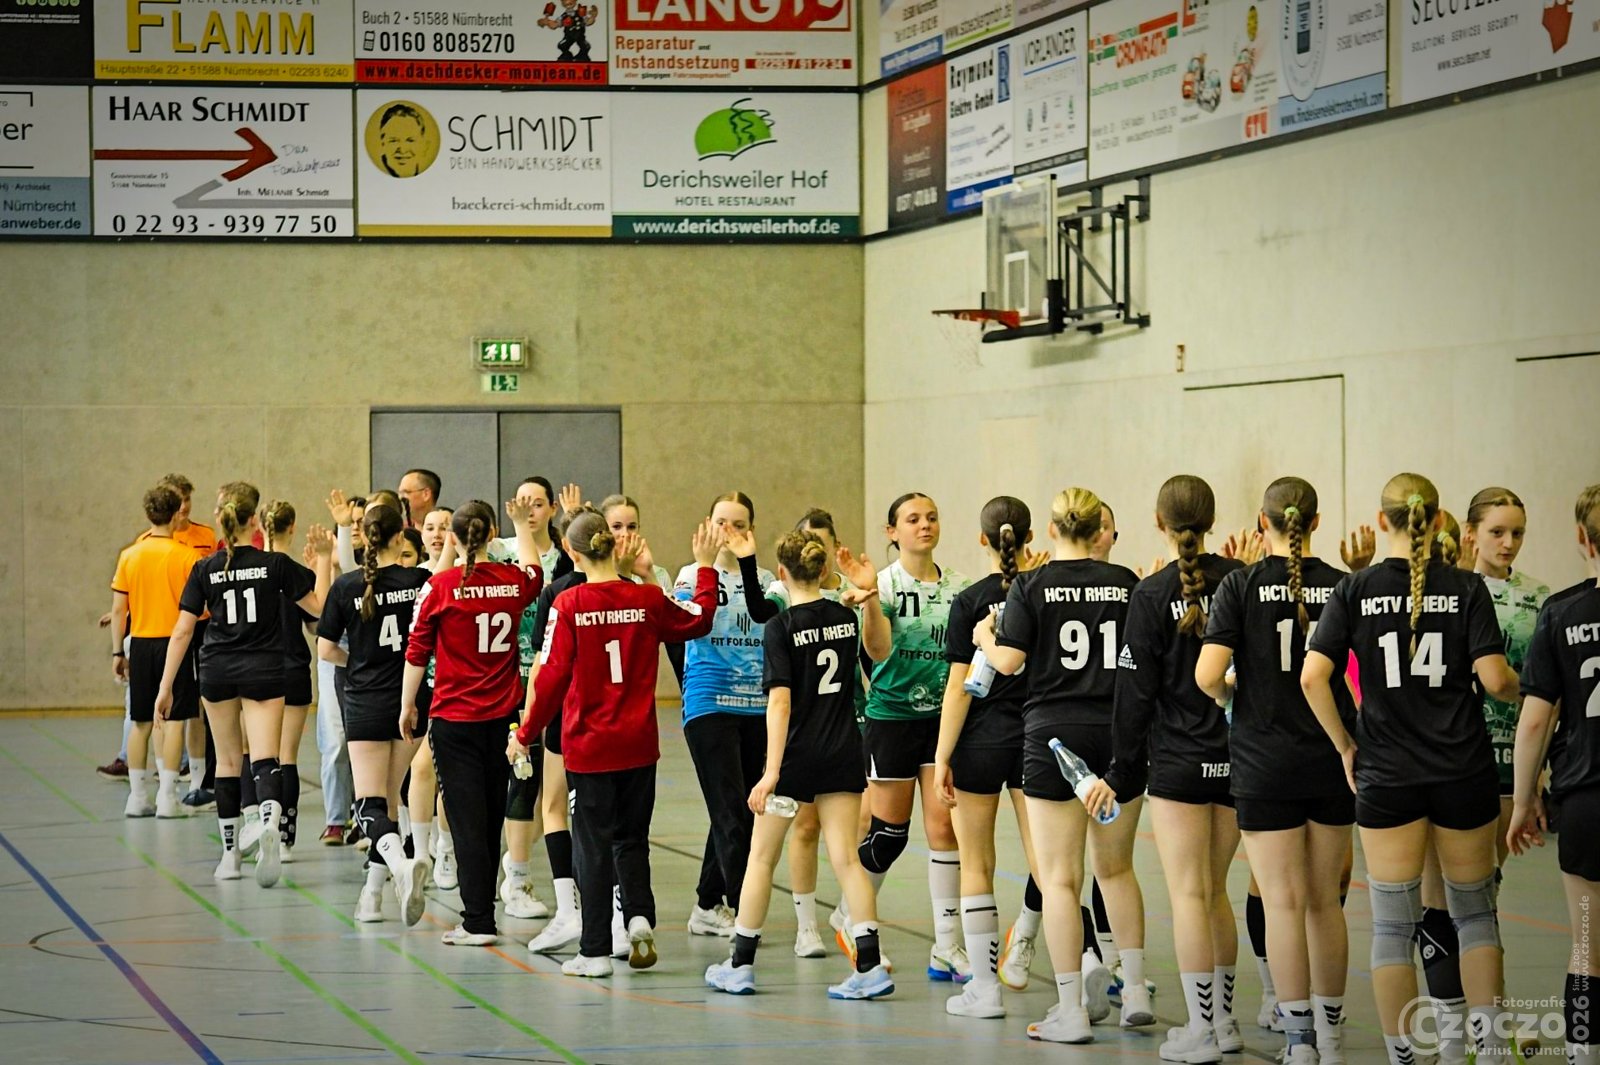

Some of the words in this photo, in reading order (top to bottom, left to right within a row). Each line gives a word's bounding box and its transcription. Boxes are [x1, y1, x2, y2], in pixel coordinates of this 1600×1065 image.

[127, 0, 314, 54] FLAMM
[362, 11, 390, 25] Buch
[394, 12, 401, 25] 2
[413, 12, 449, 25] 51588
[452, 12, 513, 26] Nümbrecht
[380, 31, 425, 52] 0160
[433, 33, 515, 53] 8085270
[616, 36, 695, 53] Reparatur
[101, 64, 163, 75] Hauptstraße
[166, 65, 179, 74] 22
[189, 66, 221, 75] 51588
[224, 66, 280, 76] Nümbrecht
[289, 68, 320, 77] 02293
[324, 68, 349, 77] 6240
[616, 55, 740, 72] Instandsetzung
[364, 64, 601, 82] www.dachdecker-monjean.de
[109, 96, 182, 121] HAAR
[192, 96, 310, 122] SCHMIDT
[0, 121, 33, 141] er
[448, 114, 603, 152] SCHMIDT
[450, 157, 477, 170] DEIN
[482, 157, 602, 171] HANDWERKSBÄCKER
[643, 170, 784, 189] Derichsweiler
[792, 170, 828, 189] Hof
[4, 199, 76, 212] Nümbrecht
[452, 197, 605, 211] baeckerei-schmidt.com
[675, 197, 714, 206] HOTEL
[718, 197, 795, 207] RESTAURANT
[112, 215, 126, 233] 0
[136, 215, 162, 233] 22
[172, 215, 198, 233] 93
[224, 215, 265, 233] 939
[275, 215, 300, 233] 77
[310, 215, 337, 233] 50
[633, 219, 840, 234] www.derichsweilerhof.de
[236, 567, 267, 581] RHEDE
[453, 586, 485, 600] HCTV
[486, 584, 519, 598] RHEDE
[1044, 587, 1081, 603] HCTV
[1085, 586, 1128, 602] RHEDE
[1301, 587, 1335, 604] RHE
[223, 587, 257, 624] 11
[354, 593, 383, 611] HV
[1361, 596, 1402, 616] HCTV
[575, 611, 605, 627] HCTV
[606, 608, 646, 624] RHEDE
[379, 614, 403, 652] 4
[475, 612, 512, 653] 12
[793, 627, 820, 647] HCTV
[823, 622, 856, 642] RHEDE
[711, 637, 725, 647] FIT
[1059, 620, 1117, 670] 91
[605, 639, 623, 683] 1
[899, 649, 917, 660] FIT
[1378, 631, 1447, 688] 14
[816, 648, 842, 694] 2
